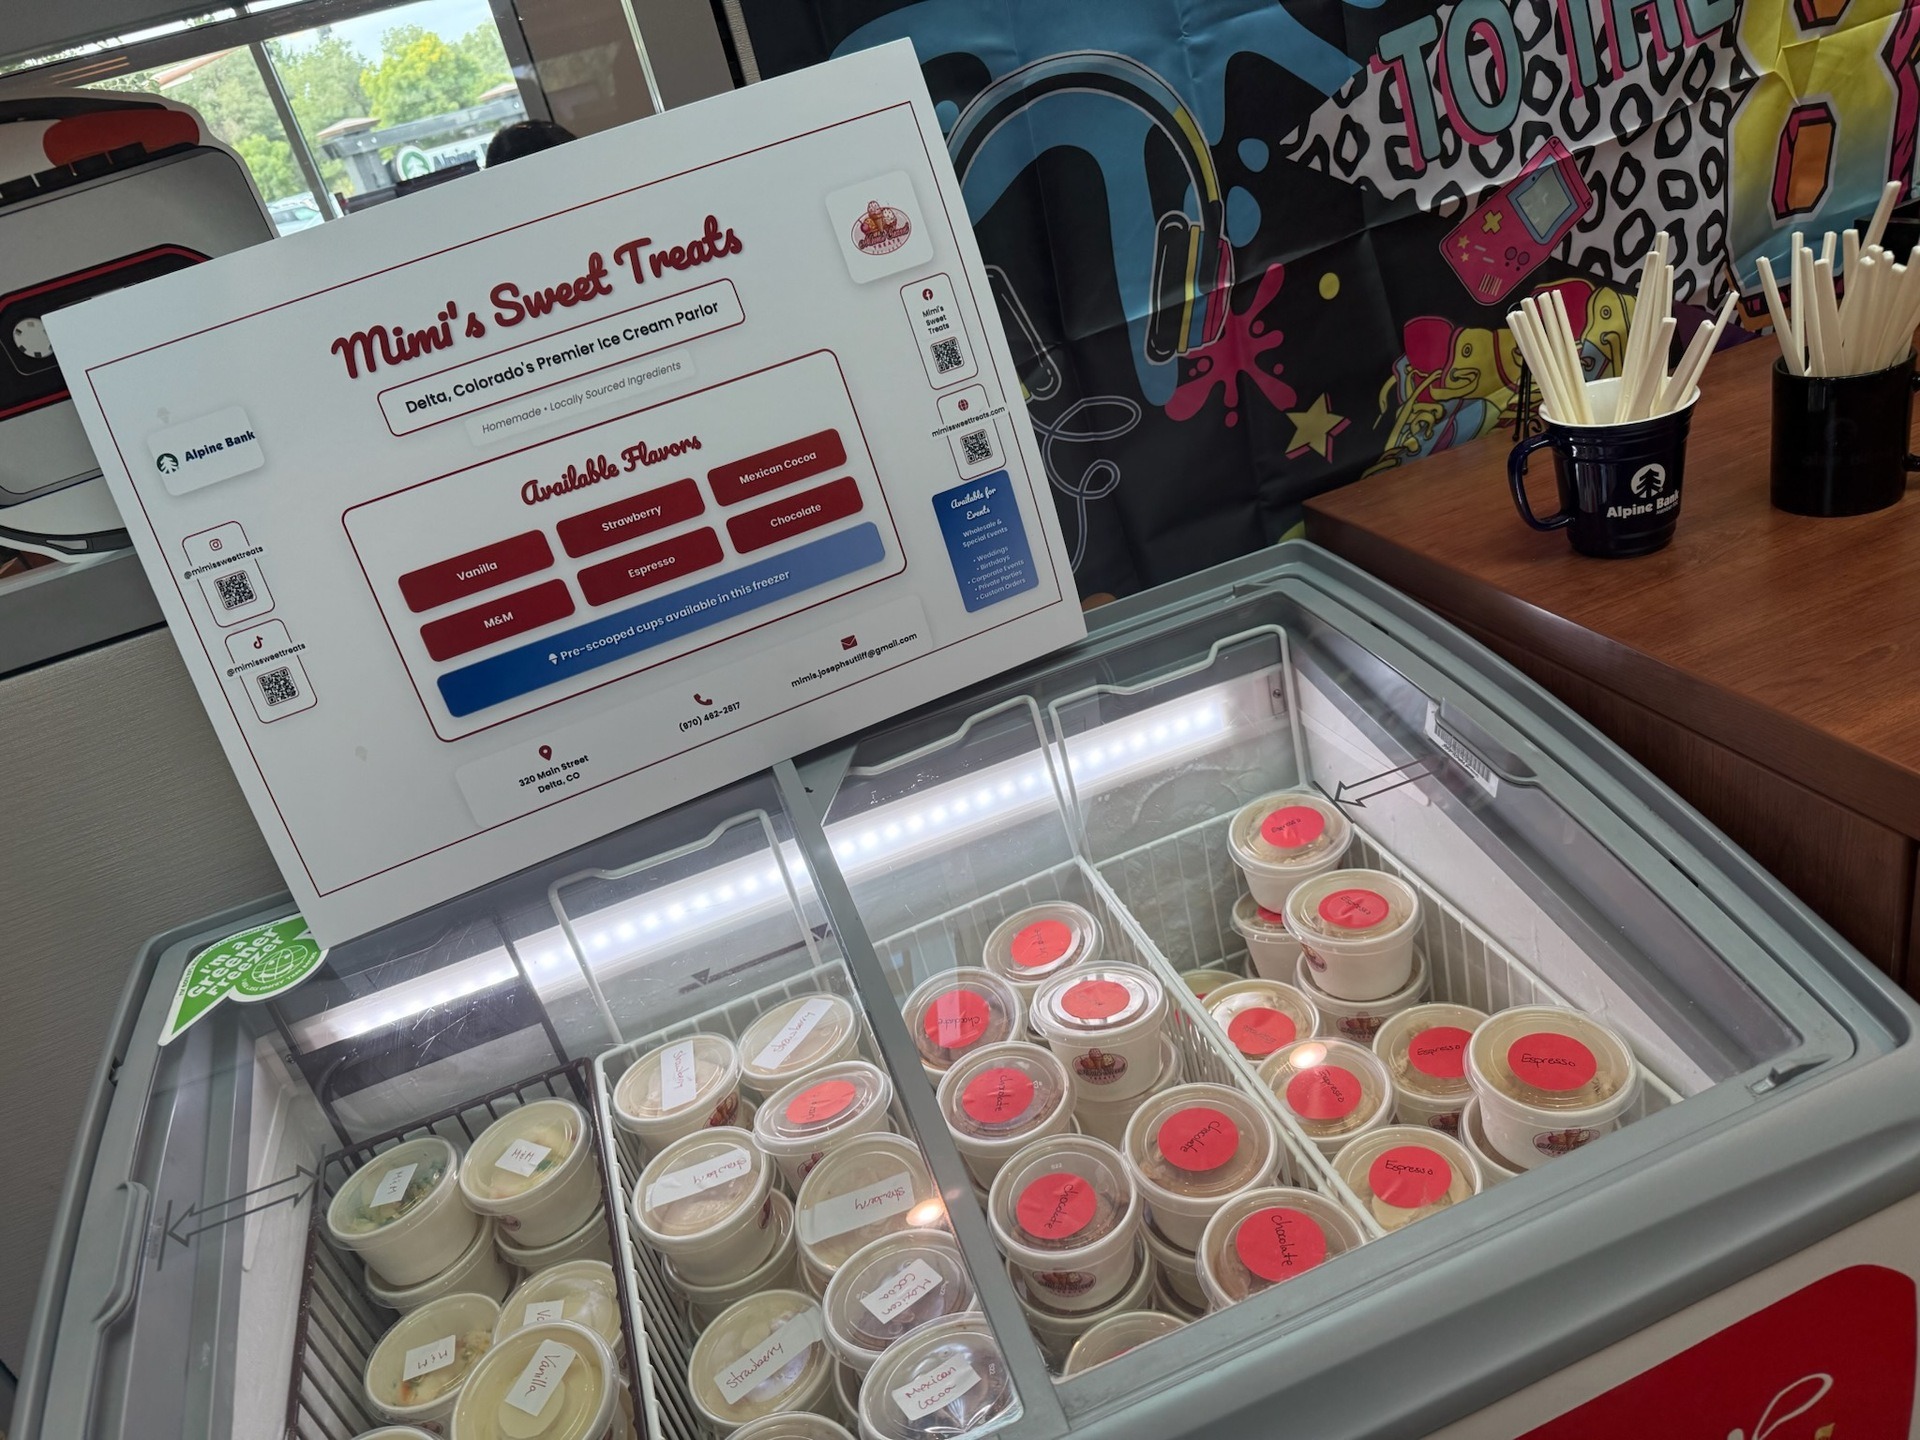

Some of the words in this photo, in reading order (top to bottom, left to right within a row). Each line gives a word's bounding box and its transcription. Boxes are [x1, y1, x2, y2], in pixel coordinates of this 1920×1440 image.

[1370, 0, 1524, 172] TO
[331, 301, 485, 379] Mimi's
[490, 252, 612, 327] Sweet
[614, 215, 743, 284] Treats
[922, 305, 944, 318] Mimi's
[926, 314, 947, 326] Sweet
[928, 322, 950, 335] Treats
[405, 389, 451, 413] Delta,
[453, 363, 535, 397] Colorado's
[537, 344, 595, 371] Premier
[598, 333, 620, 351] Ice
[623, 317, 673, 342] Cream
[675, 301, 720, 325] Parlor
[482, 407, 542, 434] Homemade
[550, 392, 583, 412] Locally
[585, 377, 625, 400] Sourced
[627, 360, 682, 389] Ingredients
[931, 405, 1006, 438] mimissweettreats.com
[185, 442, 224, 462] Alpine
[225, 430, 256, 447] Bank
[521, 455, 620, 505] Available
[622, 435, 702, 473] Flavors
[739, 462, 783, 485] Mexican
[784, 451, 817, 470] Cocoa
[951, 489, 984, 509] Available
[984, 486, 998, 499] for
[1606, 503, 1653, 519] Alpine
[1656, 489, 1680, 509] Bank
[602, 505, 662, 532] Strawberry
[770, 502, 822, 528] Chocolate
[966, 505, 990, 520] Events
[962, 522, 997, 537] Wholesale
[962, 534, 986, 548] Special
[986, 526, 1008, 539] Events
[184, 545, 264, 580] @mimissweettreats
[976, 546, 1009, 562] Weddings
[980, 554, 1011, 571] Birthdays
[456, 560, 498, 582] Vanilla
[628, 555, 676, 578] Espresso
[971, 568, 1003, 584] Corporate
[1003, 560, 1025, 572] Events
[978, 578, 1000, 590] Private
[1000, 570, 1023, 582] Parties
[980, 587, 1004, 600] Custom
[1005, 578, 1026, 590] Orders
[483, 611, 514, 629] M&M
[560, 626, 636, 662] Pre-scooped
[636, 616, 665, 636] cups
[666, 596, 718, 623] available
[718, 592, 730, 604] in
[730, 583, 752, 600] this
[752, 569, 791, 591] freezer
[227, 643, 306, 678] @mimissweettreats
[519, 775, 536, 787] 320
[537, 767, 561, 780] Main
[561, 755, 589, 770] Street
[538, 780, 565, 793] Delta,
[566, 772, 580, 781] CO
[232, 941, 248, 950] a
[187, 927, 279, 998] Greener
[1417, 1044, 1461, 1057] Espresso
[1521, 1053, 1576, 1068] Espresso
[1385, 1160, 1434, 1176] Espresso
[524, 1355, 560, 1397] Vanilla
